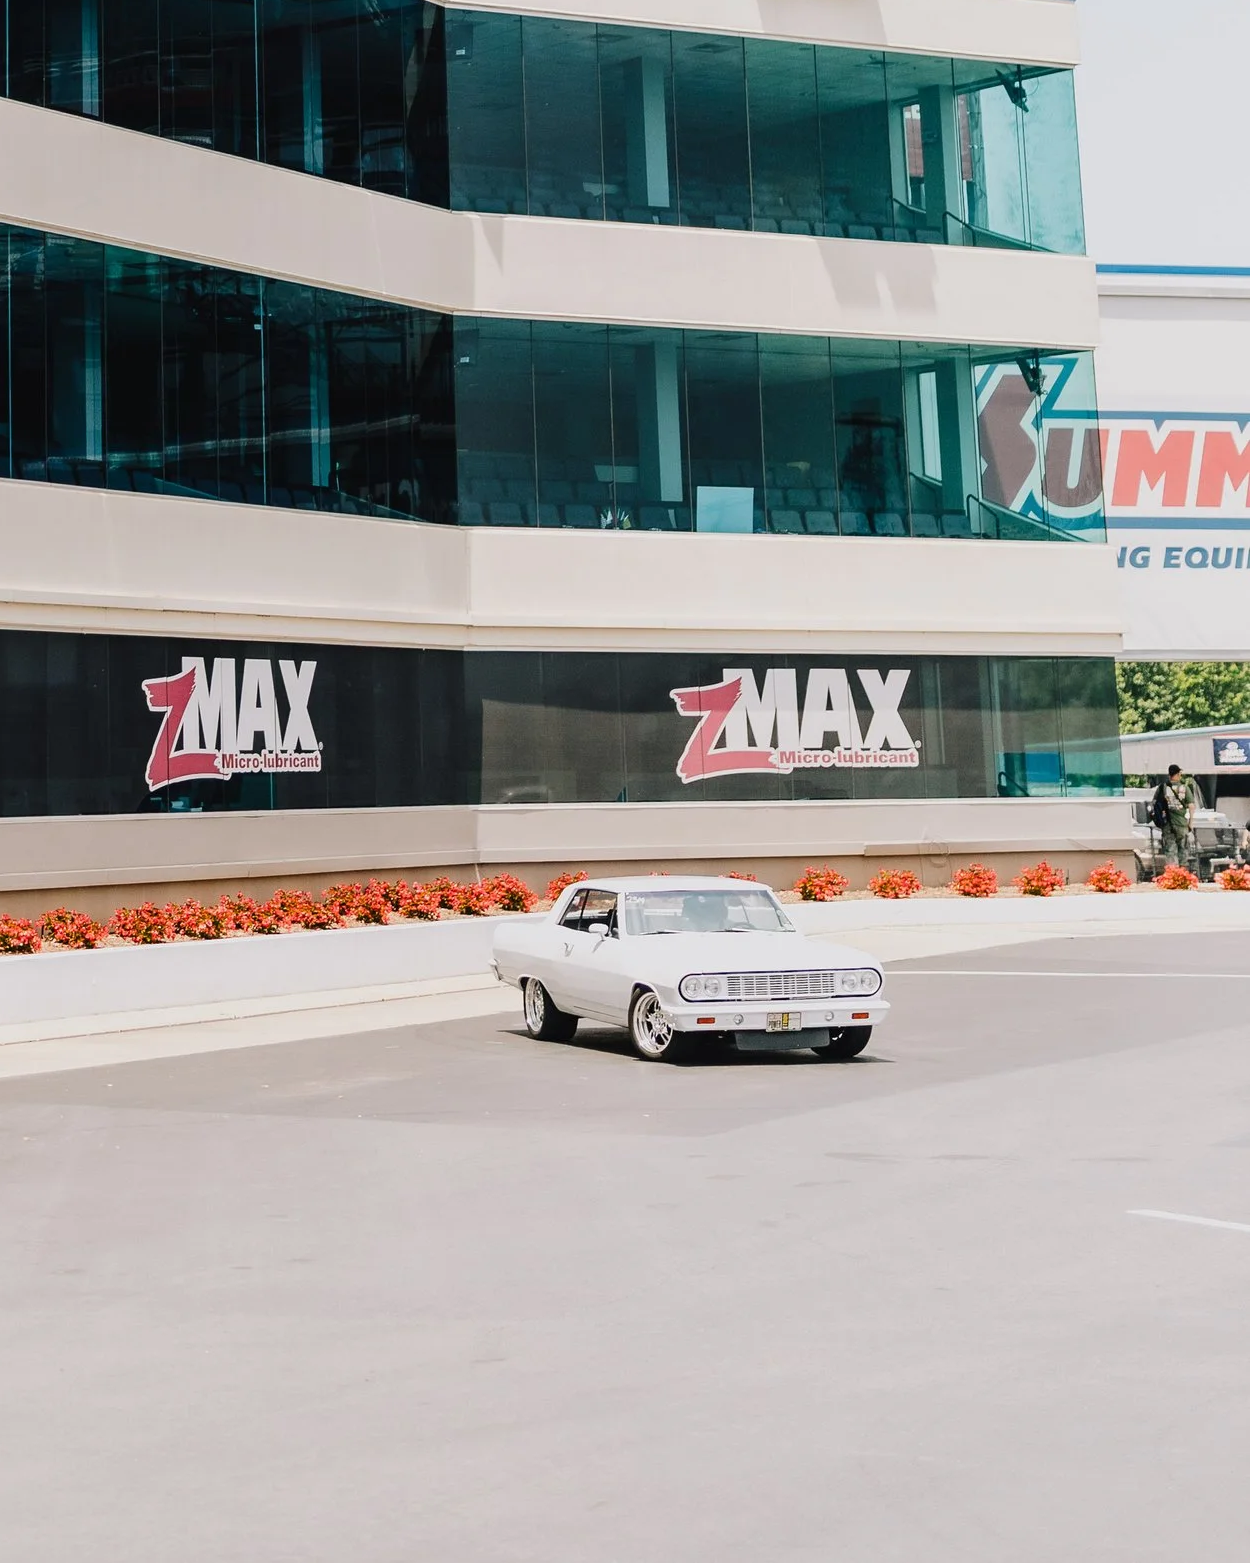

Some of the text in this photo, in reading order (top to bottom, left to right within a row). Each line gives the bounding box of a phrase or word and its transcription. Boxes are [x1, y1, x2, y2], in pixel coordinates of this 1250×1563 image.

[1163, 546, 1250, 569] EQUI
[221, 753, 319, 769] Micro-lubricant
[779, 750, 916, 765] Micro-lubricant
